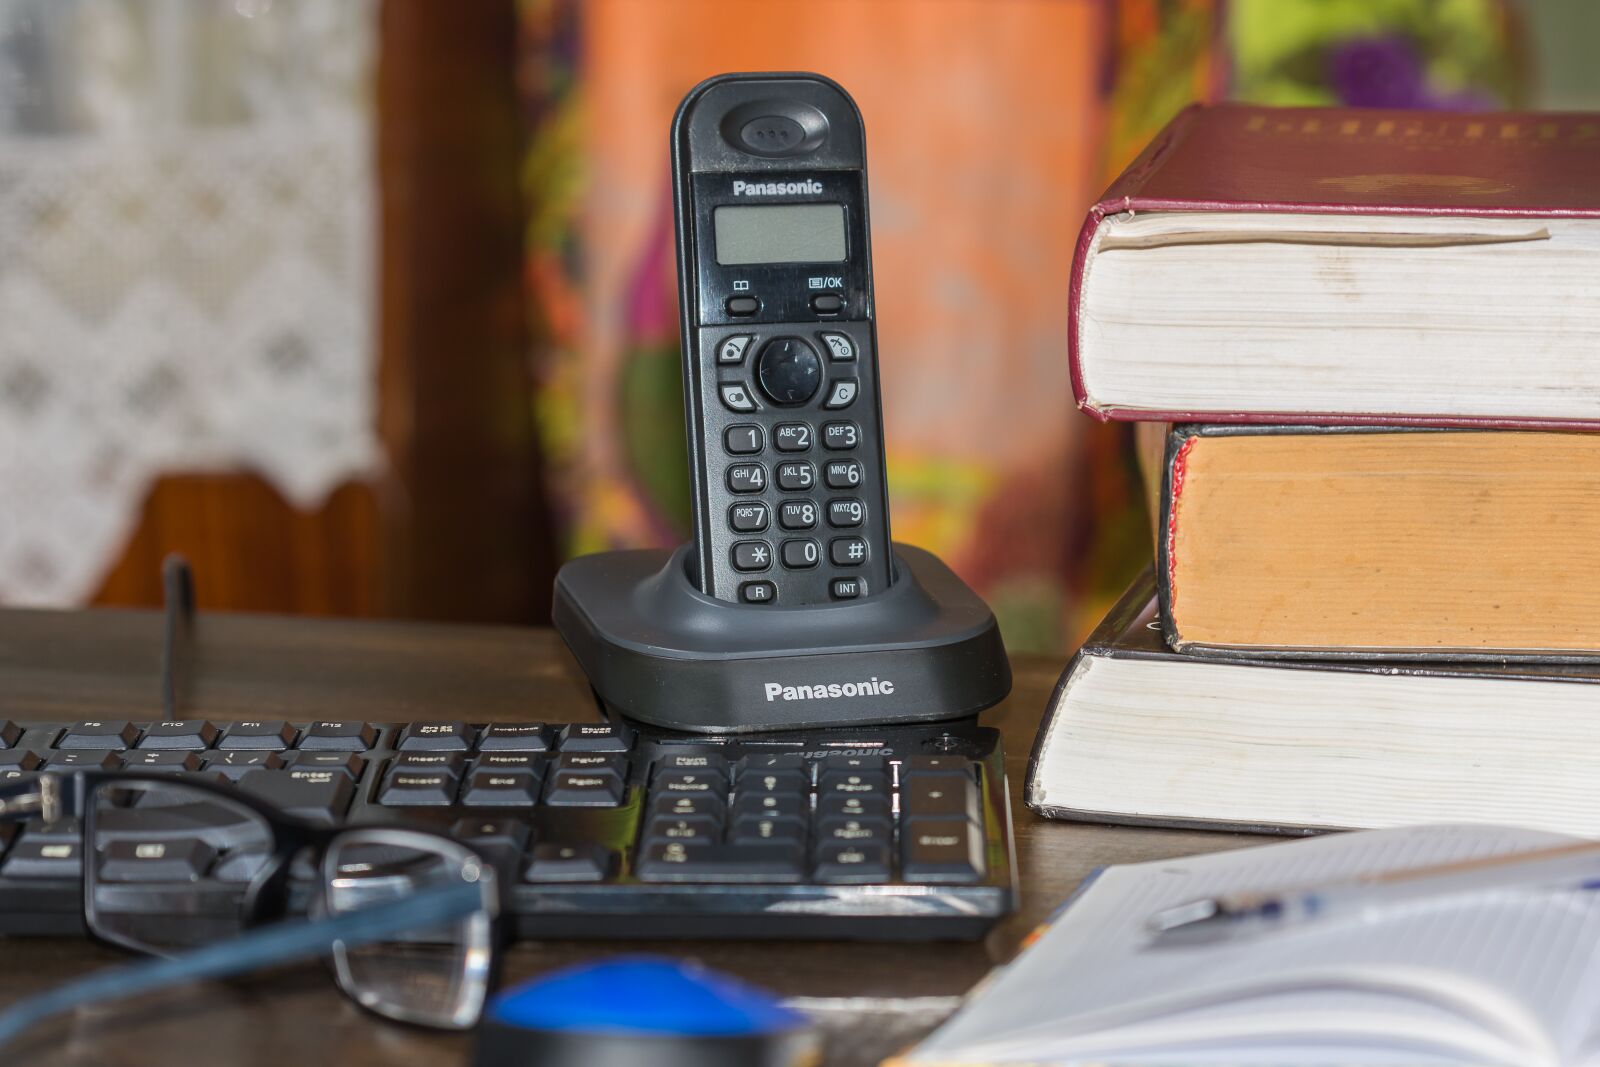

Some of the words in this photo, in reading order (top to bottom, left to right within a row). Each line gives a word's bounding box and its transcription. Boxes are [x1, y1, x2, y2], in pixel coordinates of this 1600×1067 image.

[733, 179, 823, 196] Panasonic
[838, 388, 848, 400] C
[747, 429, 756, 448] 1
[779, 427, 796, 437] ABC
[797, 426, 809, 446] 2
[828, 427, 844, 436] DEF
[845, 425, 856, 445] 3
[733, 469, 749, 479] GHI
[750, 468, 763, 487] 4
[783, 466, 798, 476] JKL
[800, 466, 811, 485] 5
[831, 465, 847, 475] MNO
[847, 464, 859, 484] 6
[736, 508, 753, 518] PQRS
[753, 507, 765, 526] 7
[786, 505, 801, 515] TUV
[802, 504, 814, 524] 8
[832, 503, 851, 513] WXYZ
[850, 502, 862, 522] 9
[804, 543, 817, 562] 0
[755, 587, 764, 598] R
[839, 583, 856, 594] INT
[764, 676, 895, 702] Panasonic
